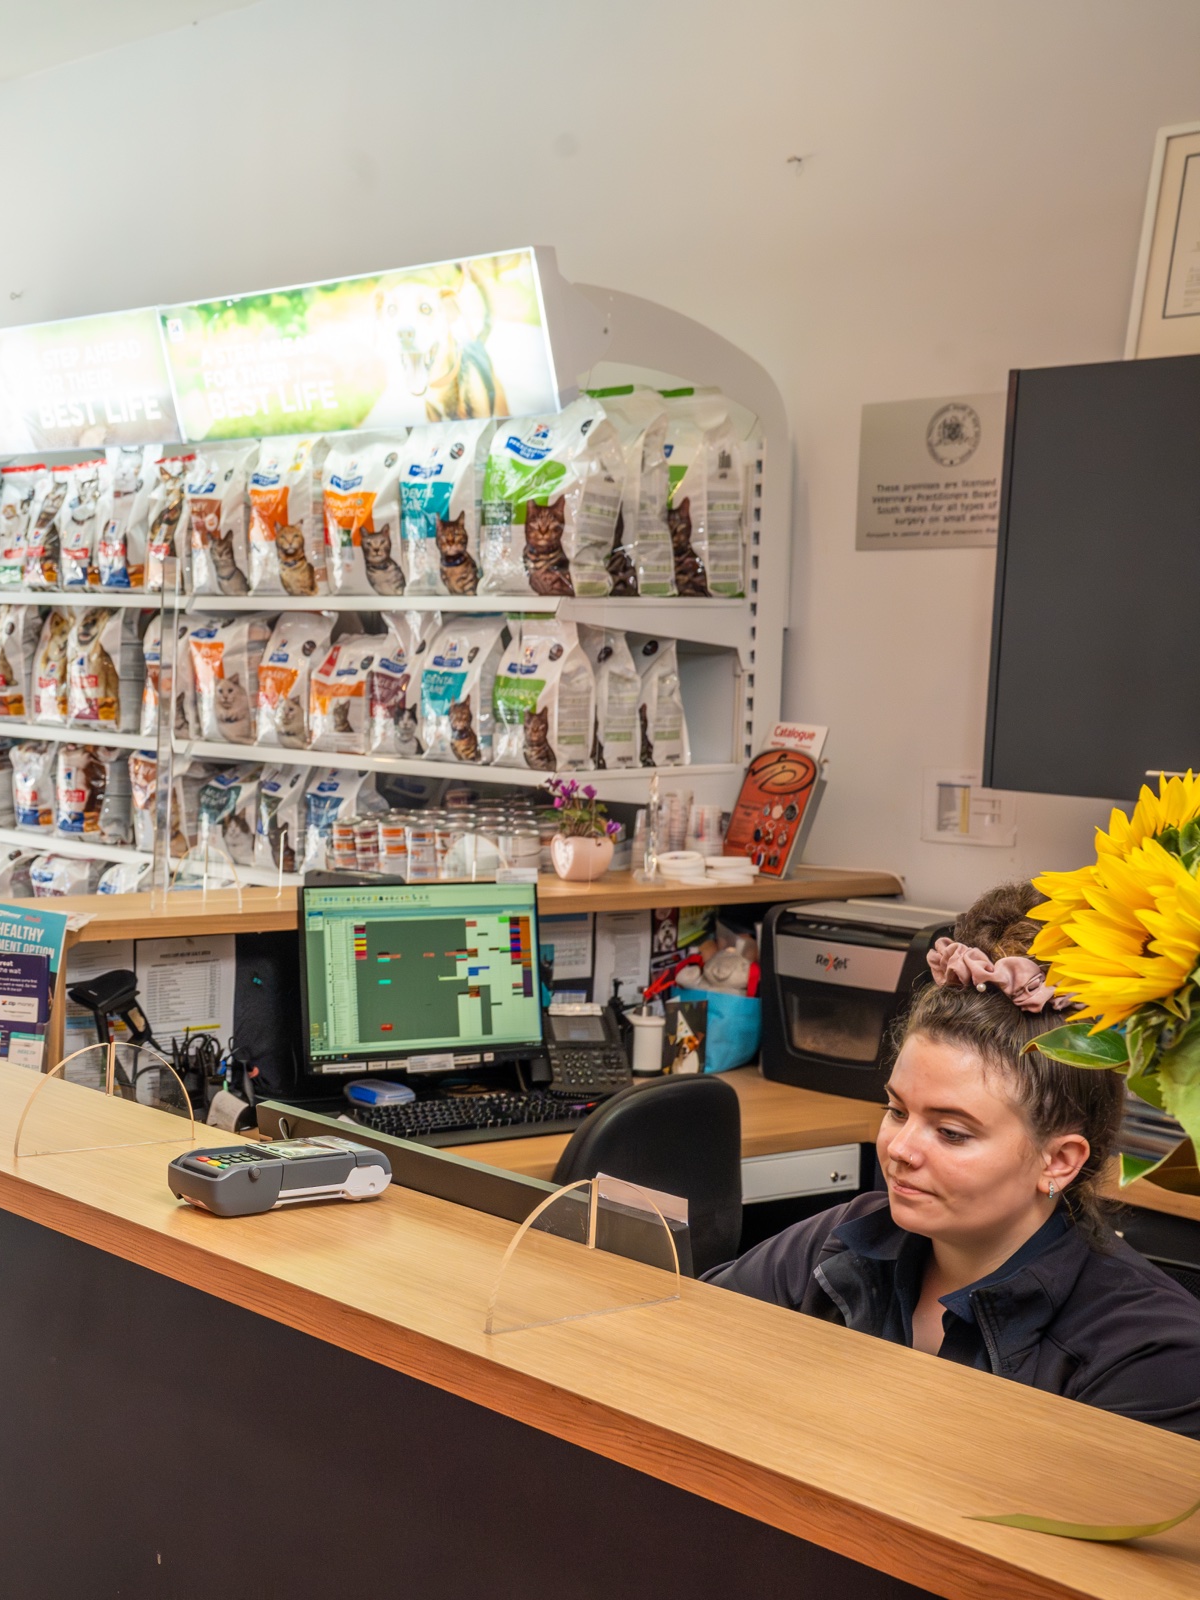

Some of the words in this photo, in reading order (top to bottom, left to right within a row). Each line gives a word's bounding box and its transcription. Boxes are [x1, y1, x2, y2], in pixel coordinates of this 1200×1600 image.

[208, 386, 270, 418] BEST
[278, 380, 338, 412] LIFE
[39, 397, 96, 429] BEST
[103, 390, 161, 424] LIFE
[774, 724, 816, 742] Catalogue
[23, 943, 55, 960] OPTION
[815, 952, 850, 972] Rexel
